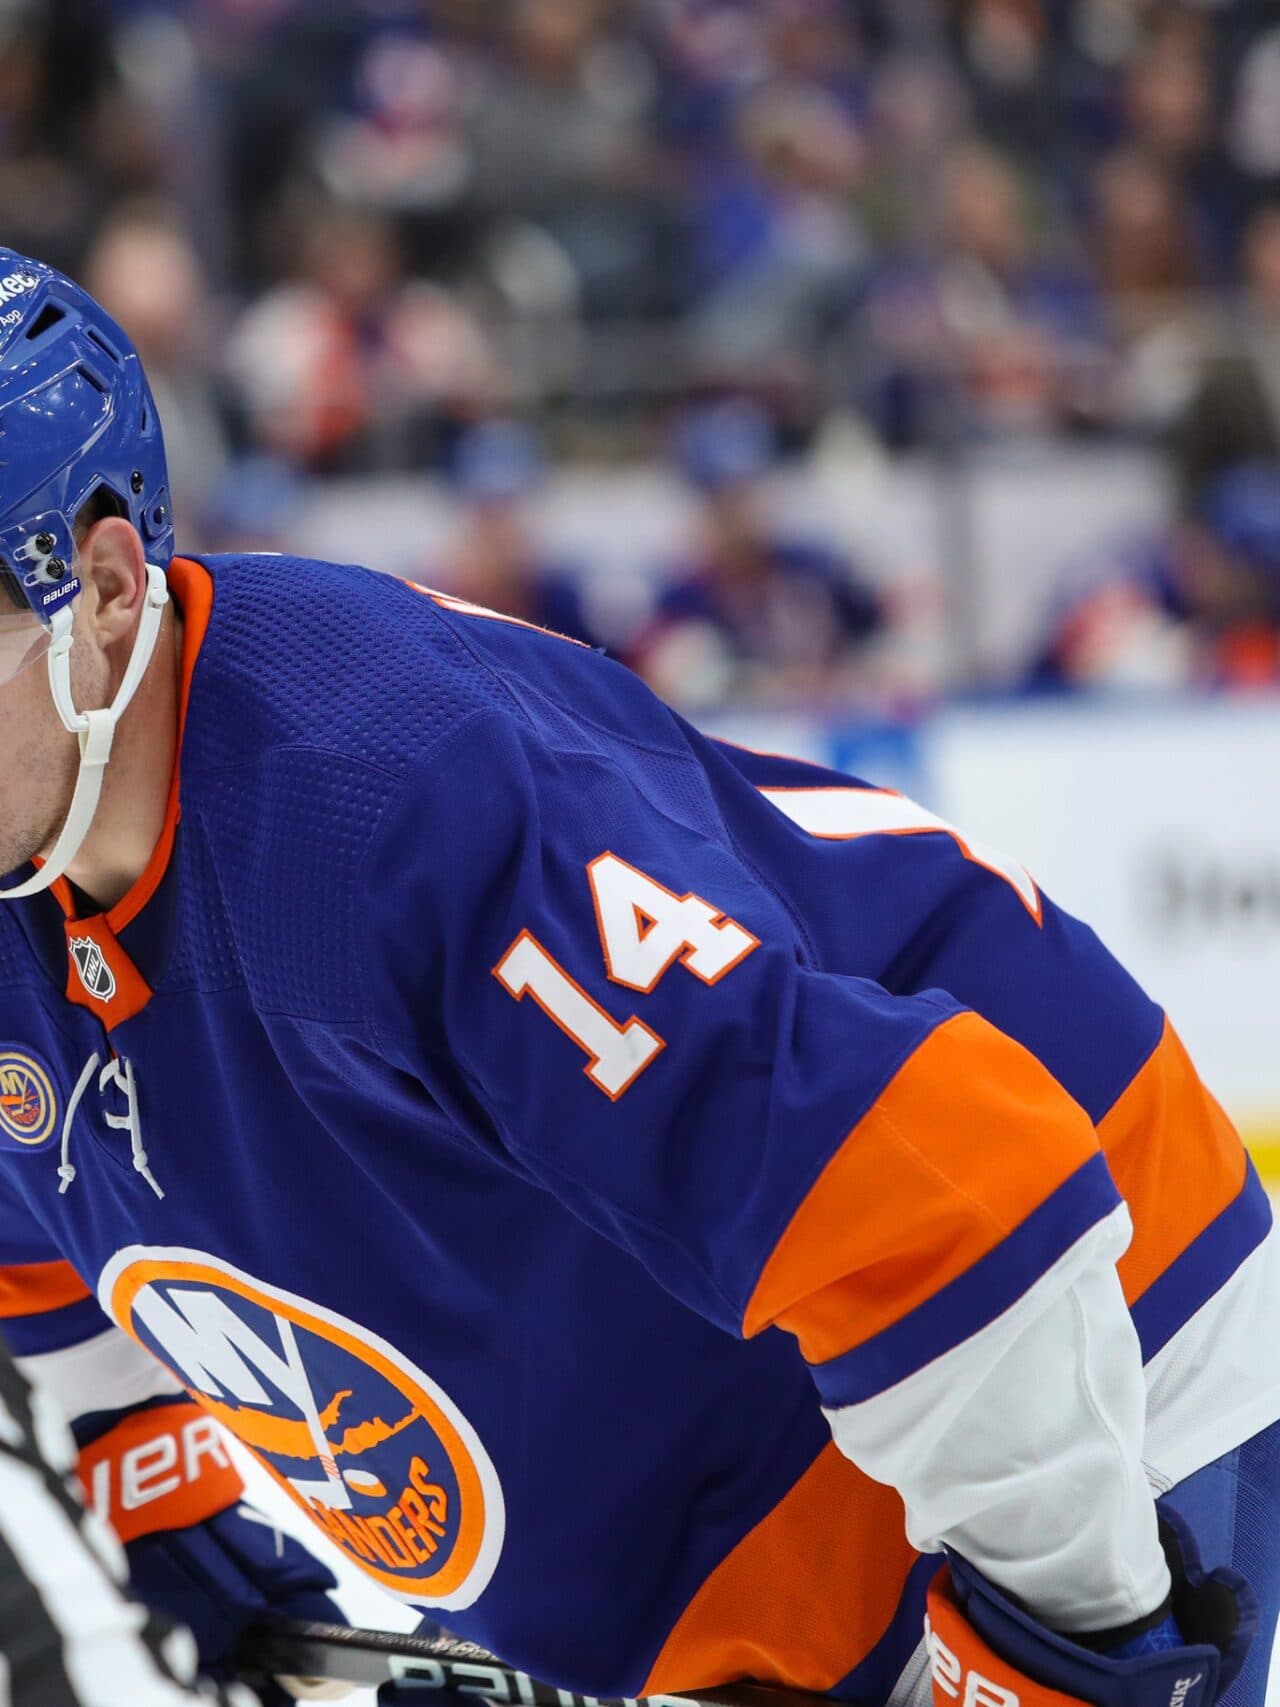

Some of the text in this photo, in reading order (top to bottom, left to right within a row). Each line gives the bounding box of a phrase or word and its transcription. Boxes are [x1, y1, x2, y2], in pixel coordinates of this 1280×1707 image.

[0, 309, 22, 327] App
[43, 579, 78, 606] BAUER
[86, 953, 100, 987] NHL
[492, 850, 761, 1102] 14
[130, 1283, 332, 1440] NY
[308, 1456, 449, 1569] ANDERS
